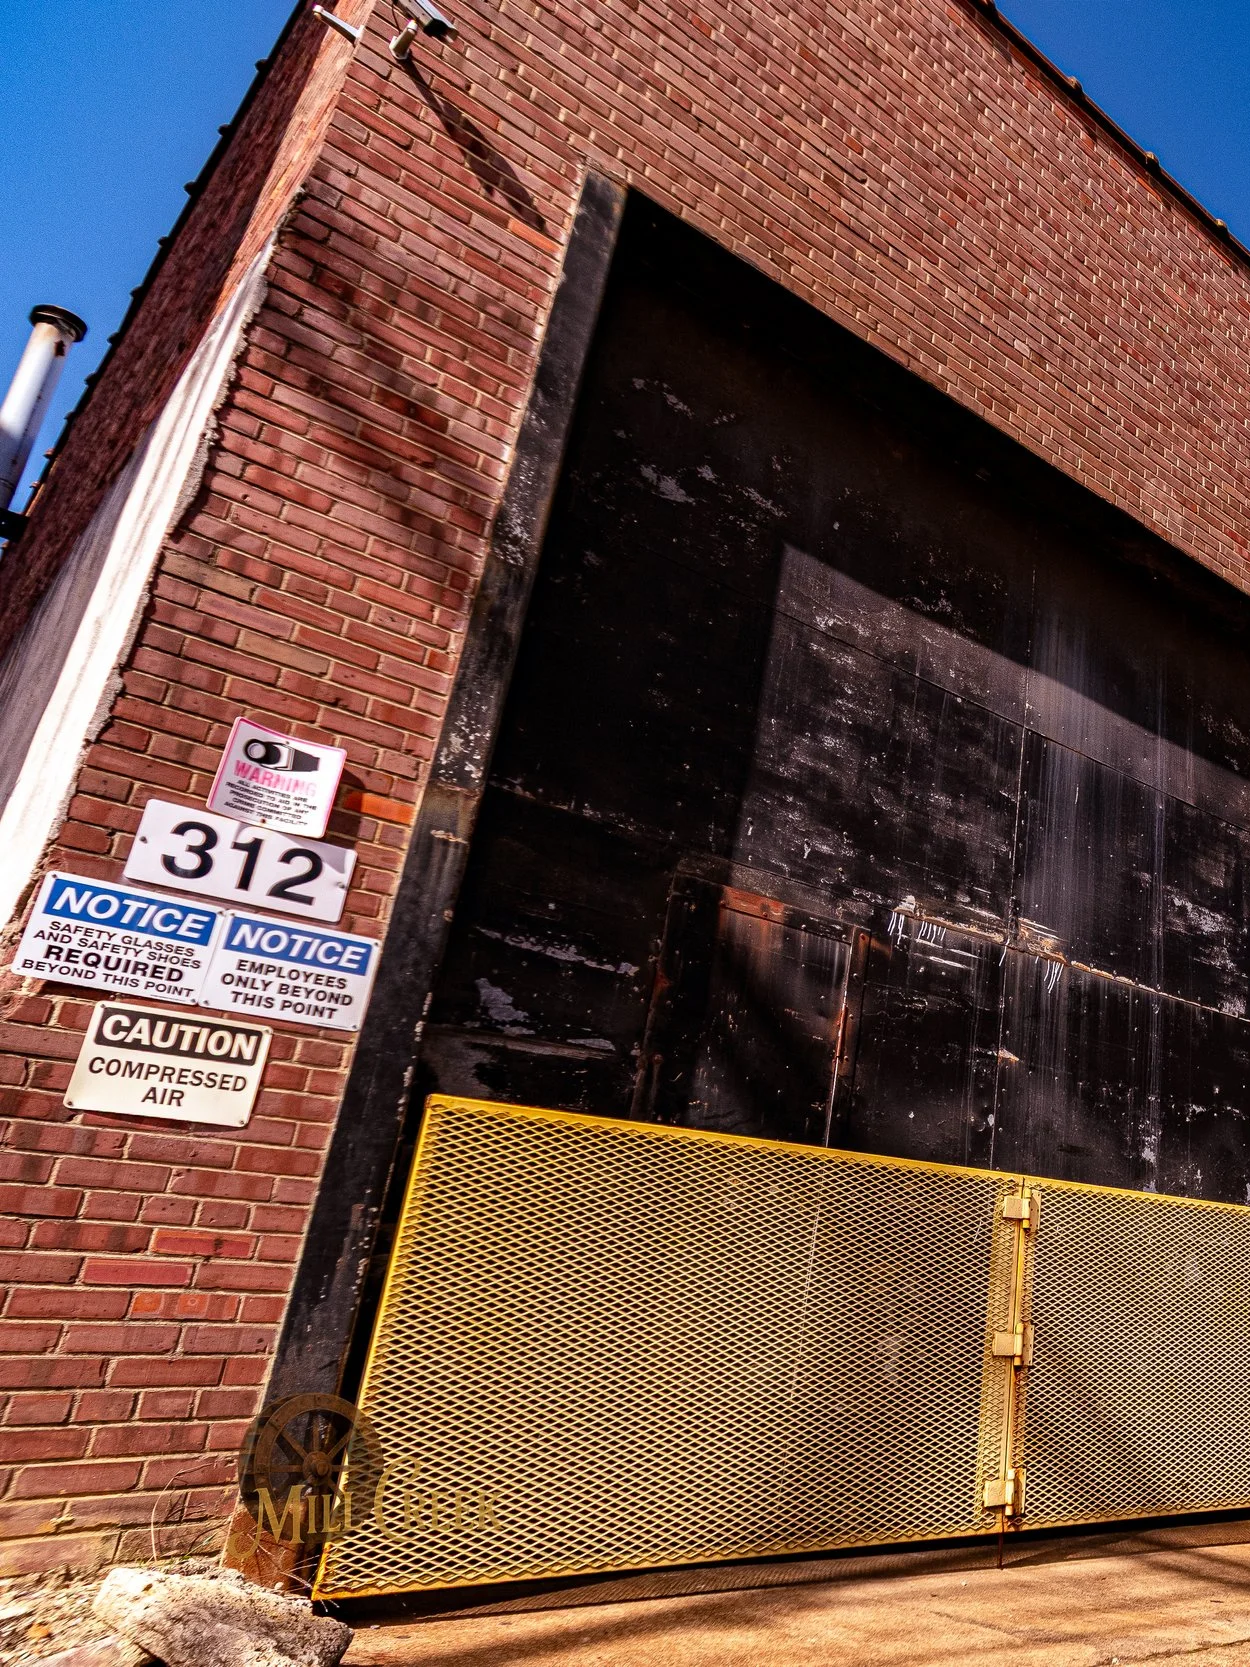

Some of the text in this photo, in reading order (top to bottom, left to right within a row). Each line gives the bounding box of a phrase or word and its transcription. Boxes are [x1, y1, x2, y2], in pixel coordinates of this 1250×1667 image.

[225, 781, 264, 798] RECORDED
[233, 760, 317, 796] WARNING
[253, 784, 291, 799] ACTIVITIES
[229, 789, 280, 808] PROSECUTION
[232, 797, 302, 819] CRIME COMMITTED
[256, 811, 272, 820] THIS
[275, 816, 308, 825] FACILITY
[161, 820, 324, 906] 312
[52, 886, 211, 939] NOTICE
[33, 930, 202, 969] AND SAFETY SHOES
[49, 921, 195, 957] SAFETY GLASSES
[230, 924, 367, 969] NOTICE
[22, 959, 96, 980] BEYOND
[102, 973, 140, 988] THIS
[144, 981, 194, 998] POINT
[43, 944, 184, 982] REQUIRED
[235, 959, 347, 989] EMPLOYEES
[221, 973, 353, 1006] ONLY BEYOND
[230, 991, 338, 1019] THIS POINT
[102, 1014, 258, 1060] CAUTION
[88, 1056, 247, 1092] COMPRESSED
[141, 1086, 185, 1107] AIR
